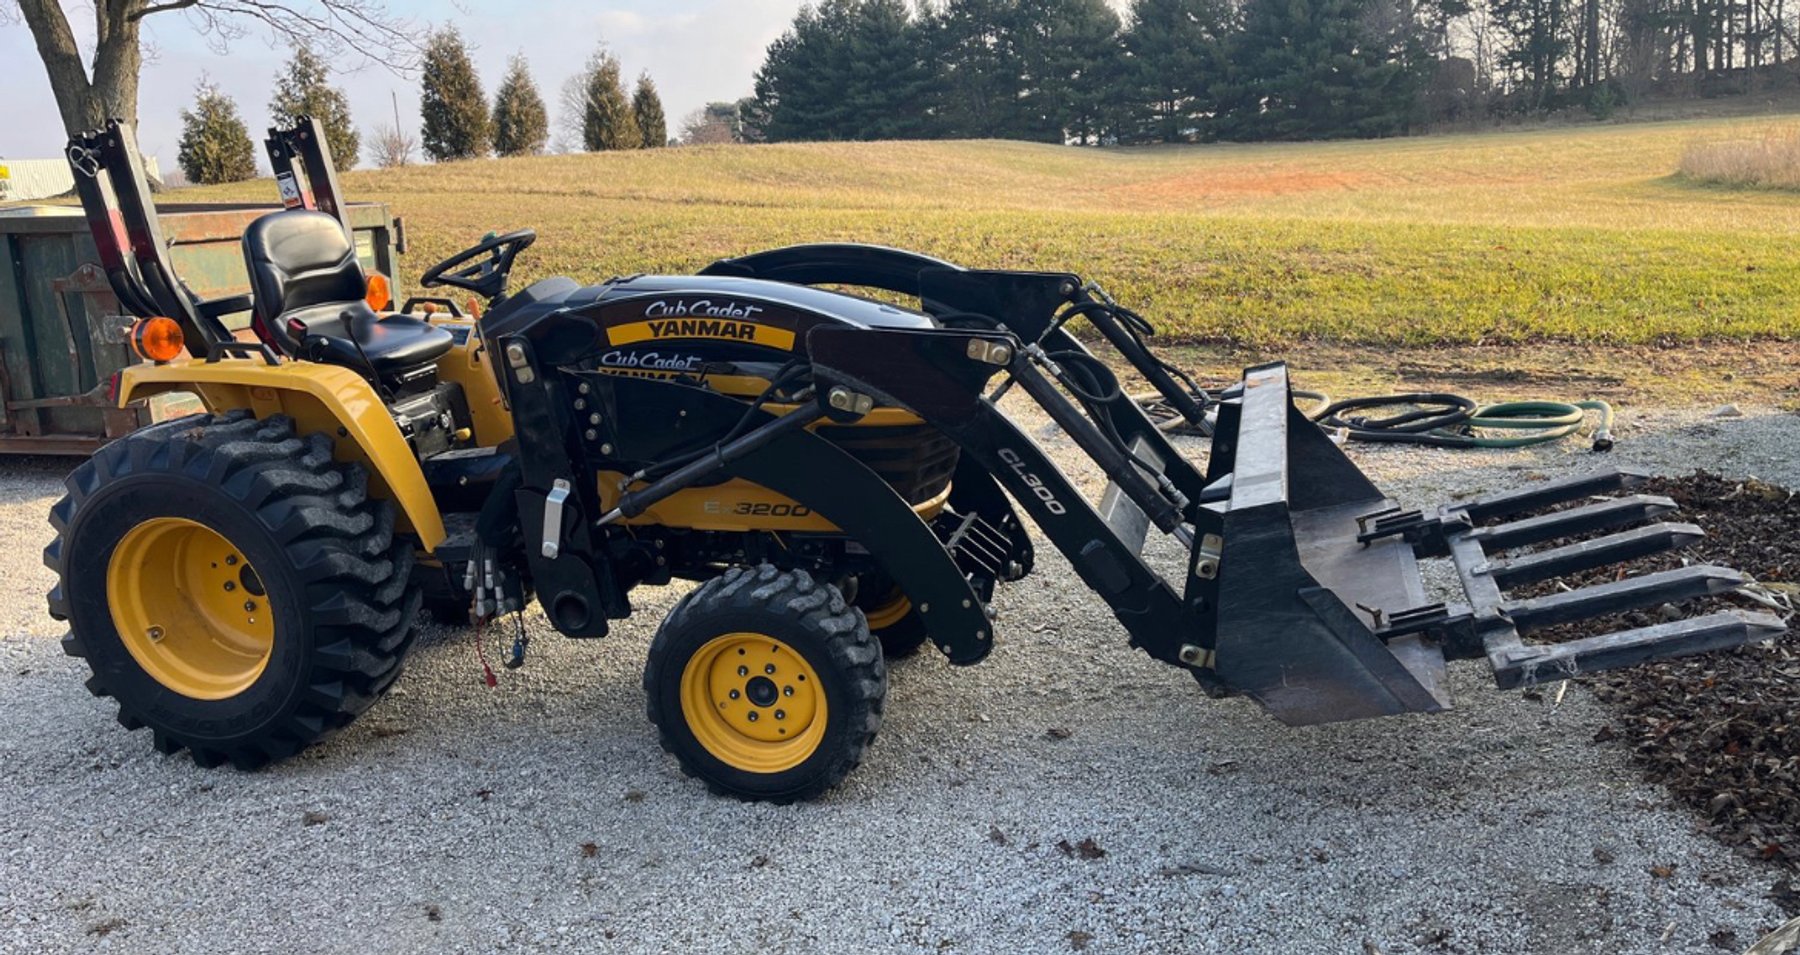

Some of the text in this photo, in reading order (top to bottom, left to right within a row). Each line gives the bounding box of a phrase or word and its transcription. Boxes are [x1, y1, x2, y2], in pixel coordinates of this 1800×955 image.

[644, 299, 763, 321] Cub Cadet
[648, 320, 756, 341] YANMAR
[601, 350, 702, 371] Cub Cadet
[997, 447, 1067, 515] CL300
